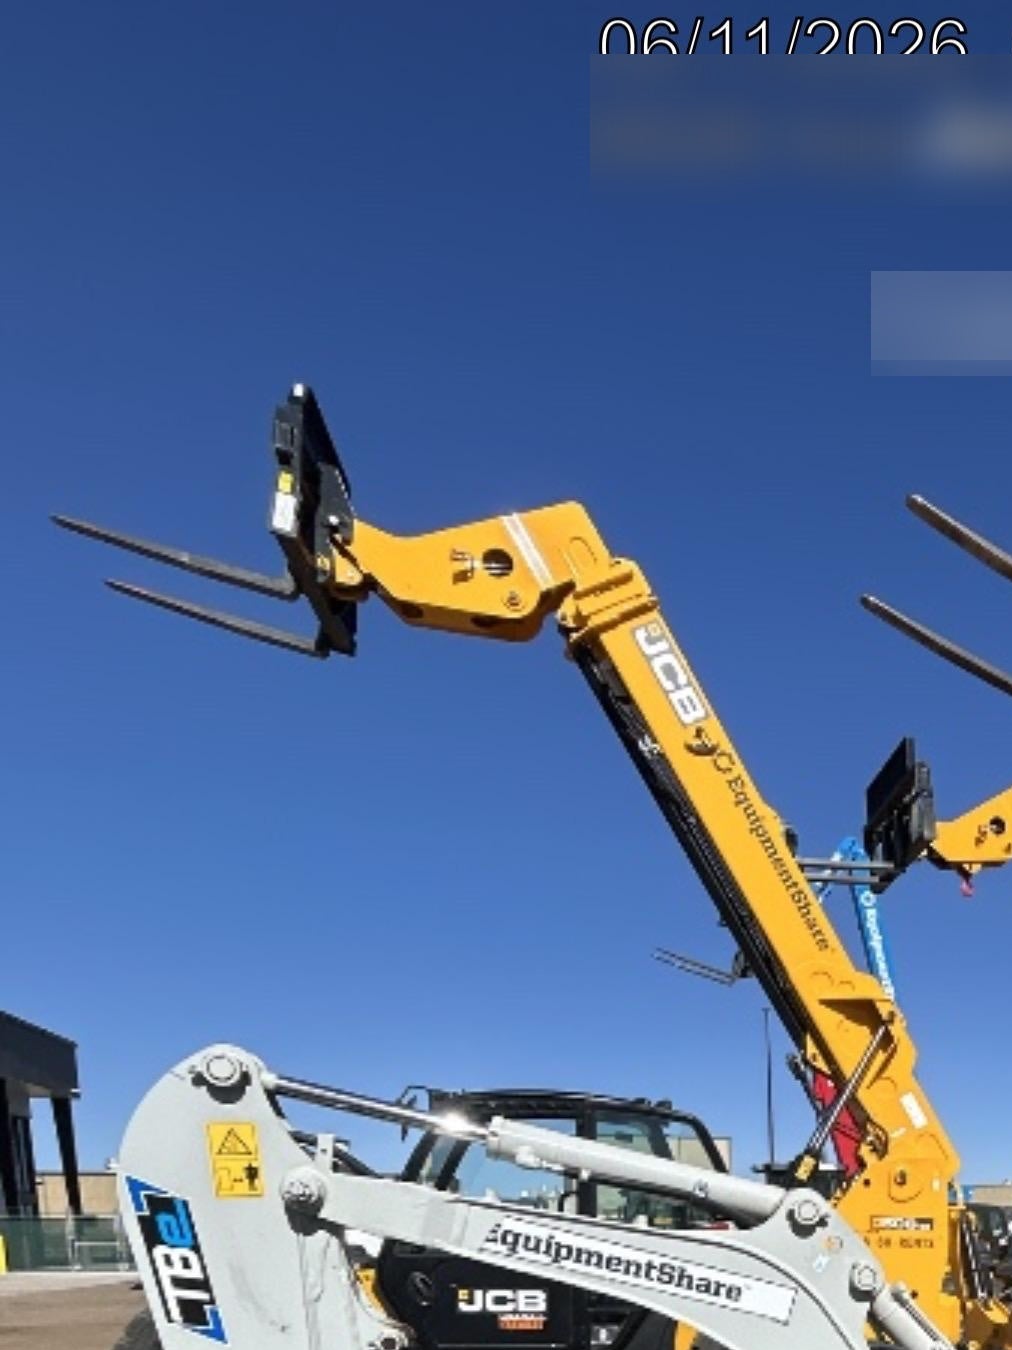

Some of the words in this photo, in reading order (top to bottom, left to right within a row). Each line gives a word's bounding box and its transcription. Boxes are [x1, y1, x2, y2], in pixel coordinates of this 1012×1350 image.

[634, 622, 708, 725] JCB
[727, 773, 830, 951] EquipmentShare
[457, 1289, 547, 1312] JCB
